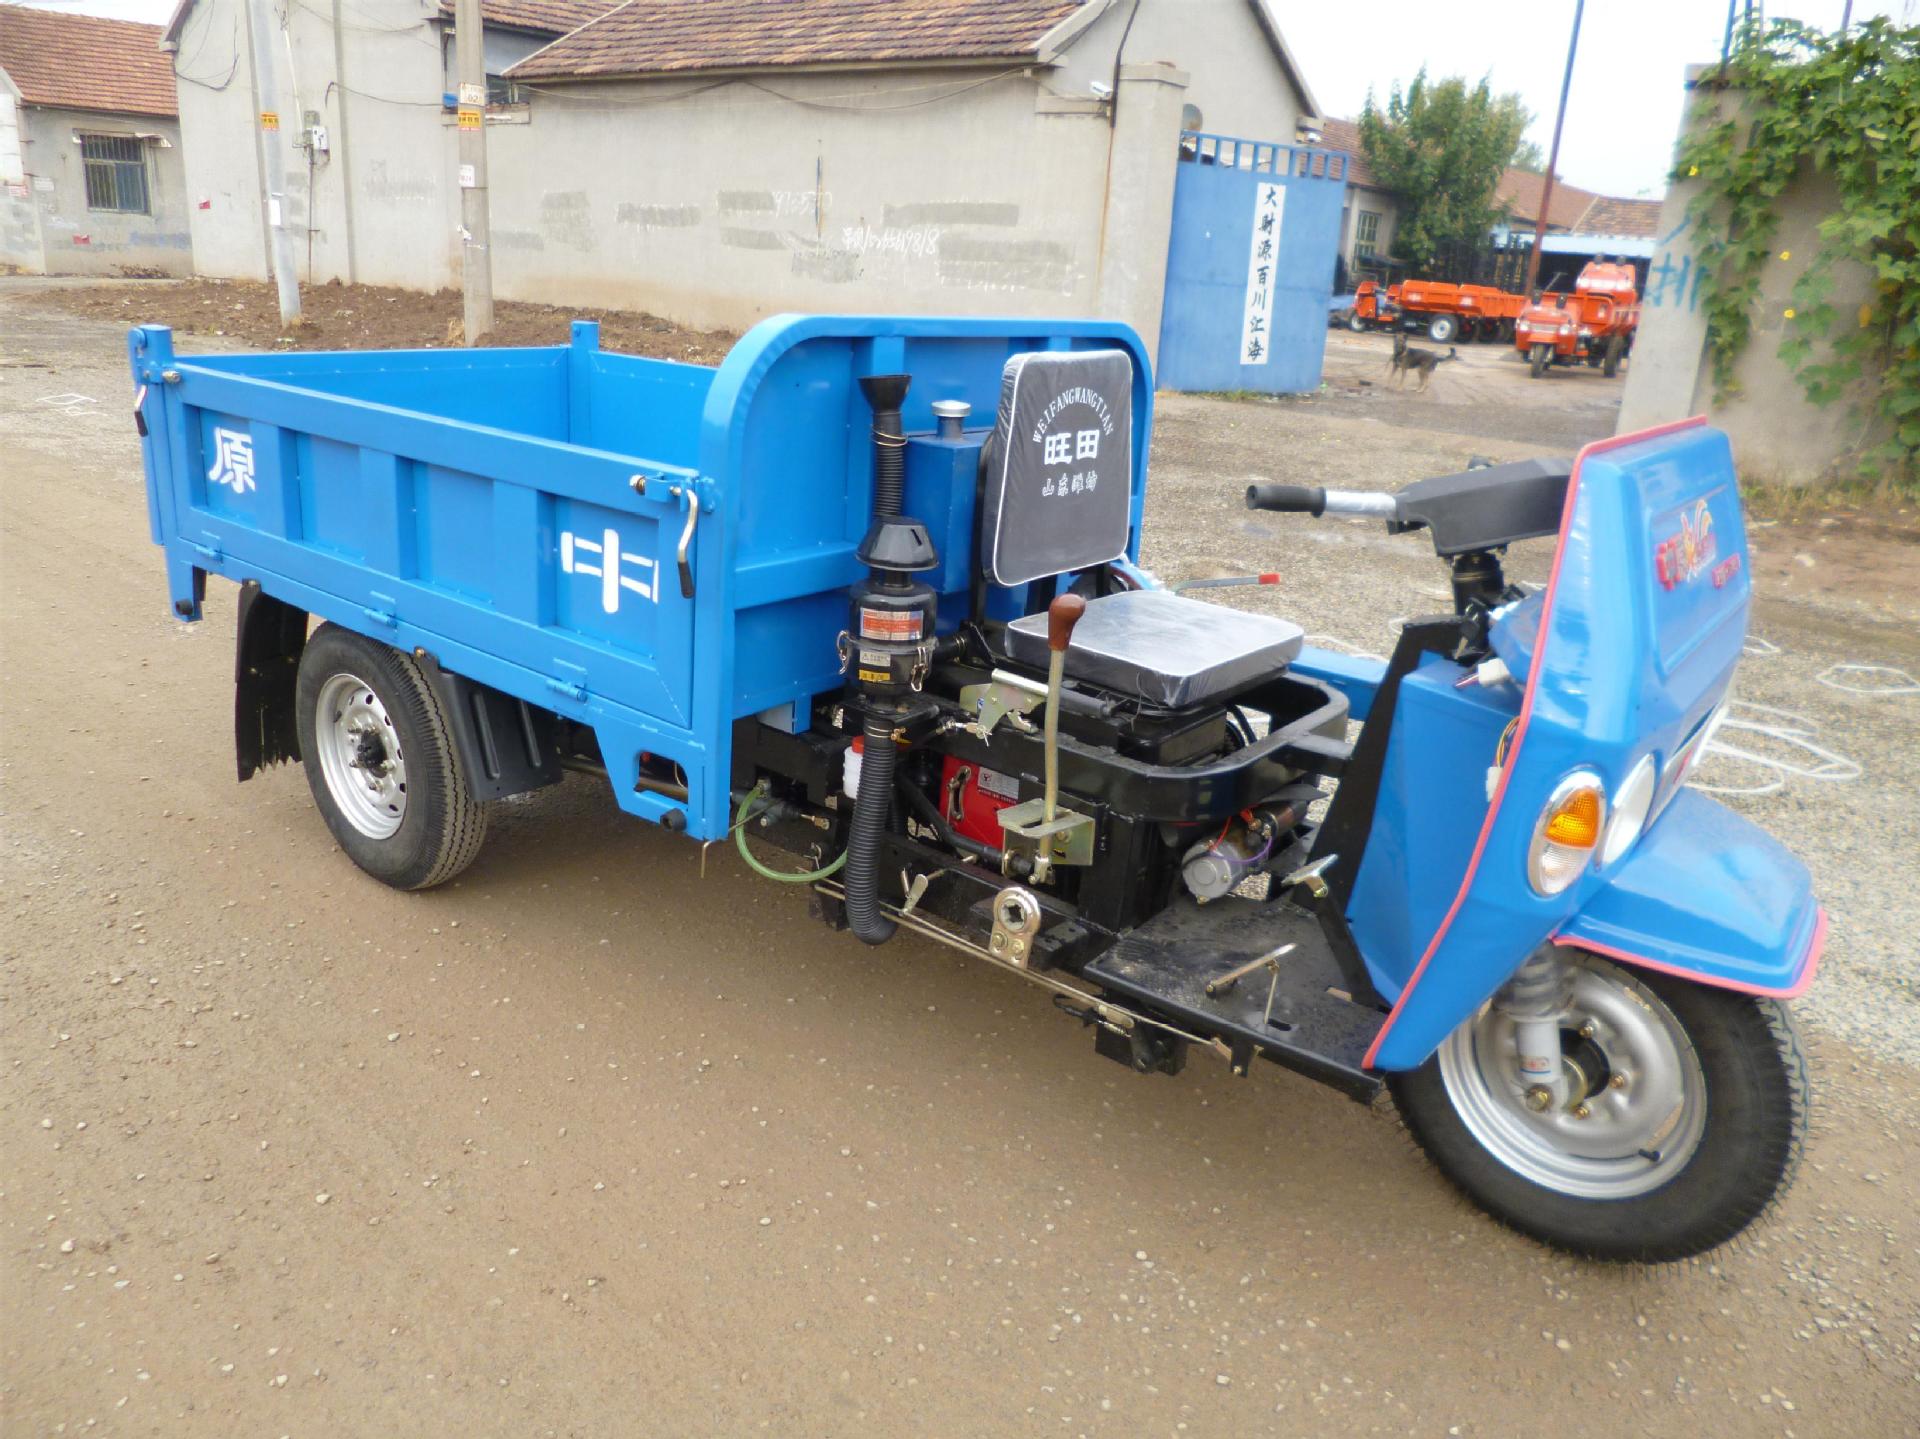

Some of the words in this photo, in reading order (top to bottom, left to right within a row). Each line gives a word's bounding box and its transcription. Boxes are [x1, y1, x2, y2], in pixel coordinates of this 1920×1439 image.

[1032, 386, 1114, 443] WEIFANGWANGTIAN
[208, 427, 256, 494] 原
[1044, 429, 1100, 465] 旺田
[560, 528, 659, 614] 中
